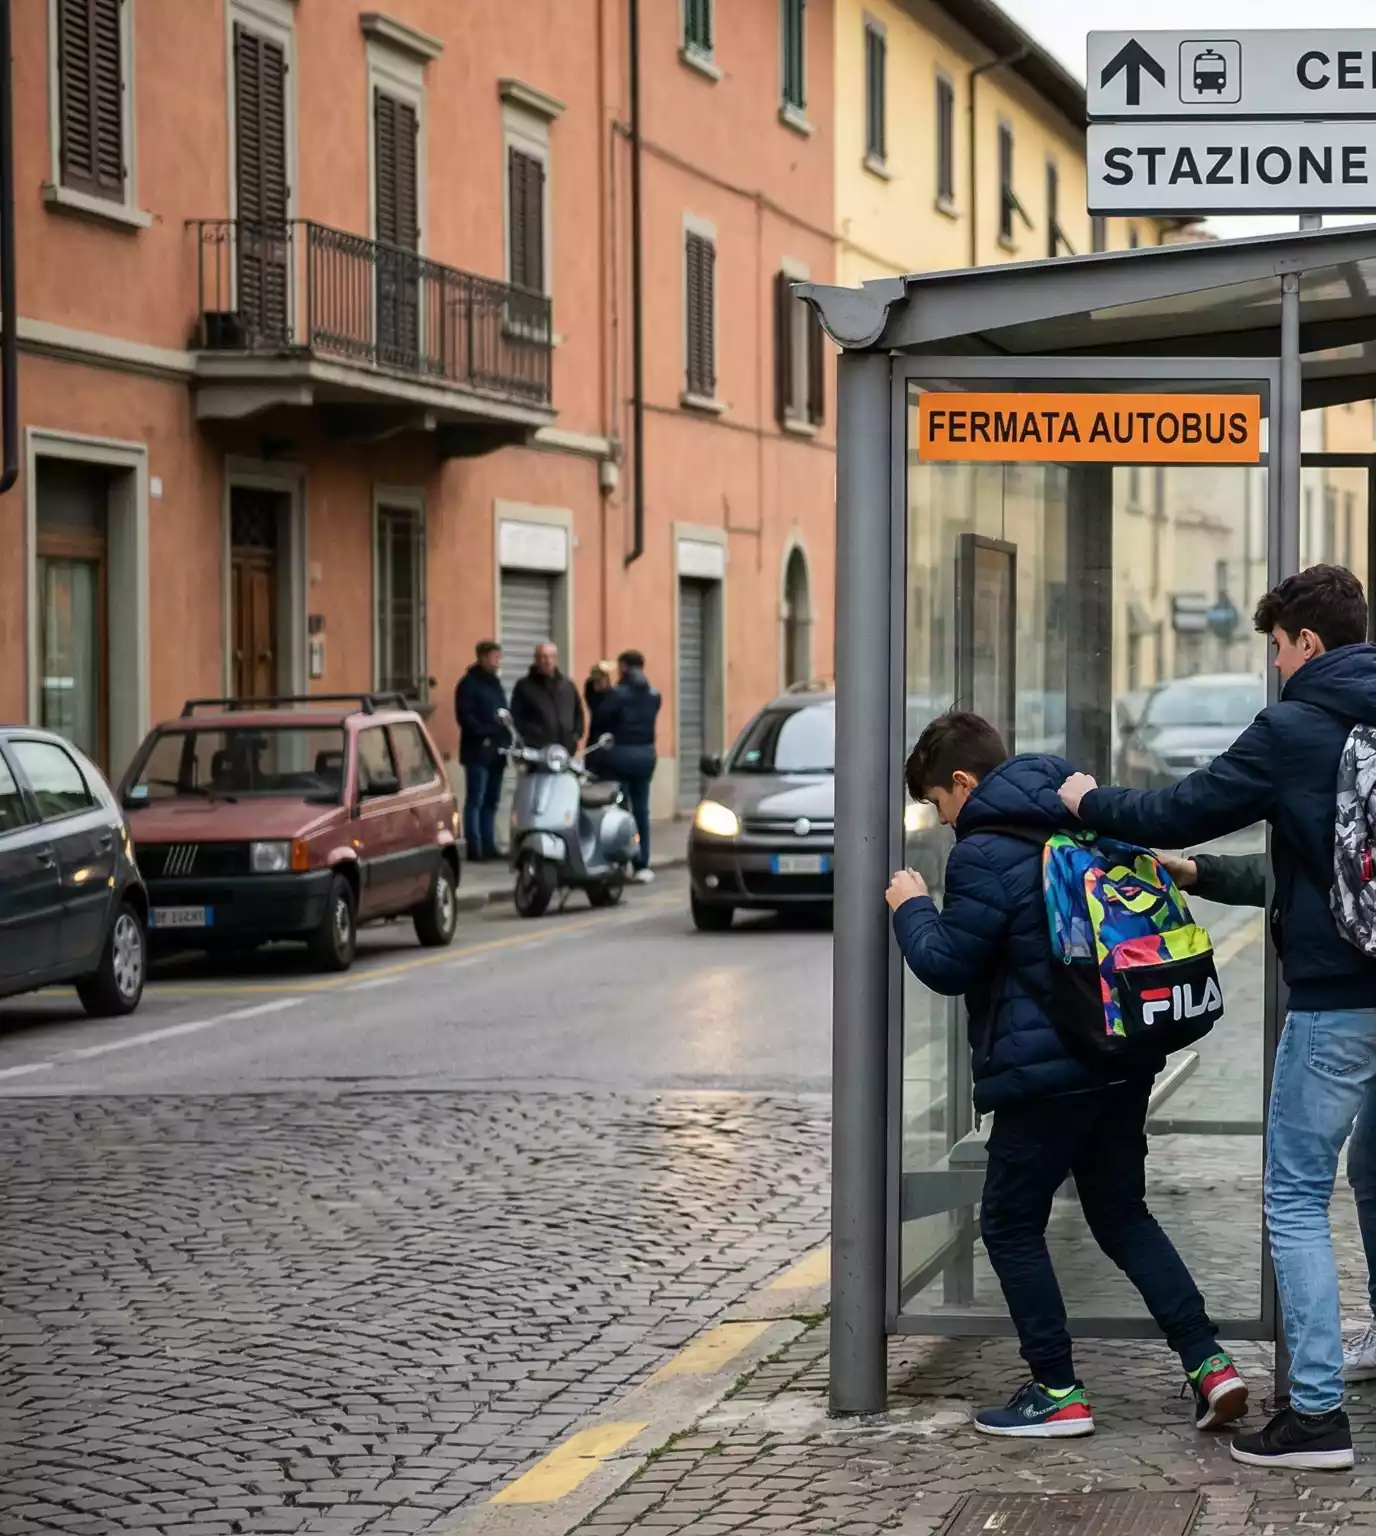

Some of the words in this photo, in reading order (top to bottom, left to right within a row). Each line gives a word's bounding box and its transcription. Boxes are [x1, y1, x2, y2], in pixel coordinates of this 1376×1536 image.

[1102, 145, 1369, 185] STAZIONE
[928, 411, 1081, 443] FERMATA
[1089, 412, 1248, 445] AUTOBUS
[1140, 976, 1222, 1025] FILA
